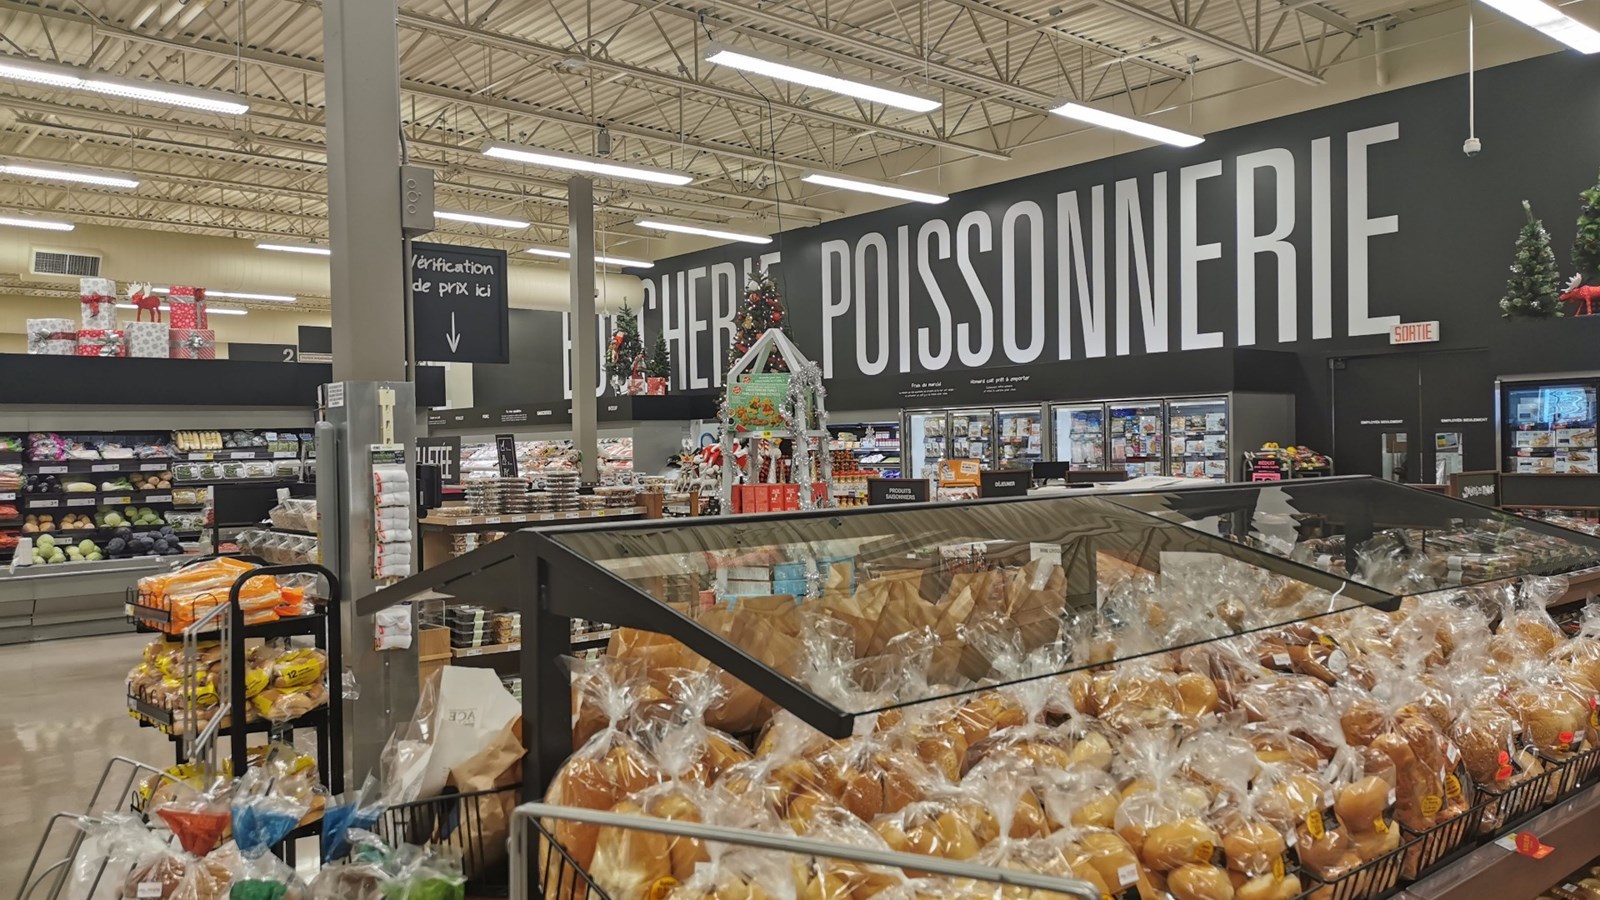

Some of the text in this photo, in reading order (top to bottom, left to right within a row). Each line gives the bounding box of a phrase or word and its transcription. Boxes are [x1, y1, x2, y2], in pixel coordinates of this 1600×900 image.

[820, 121, 1402, 381] POISSONNERIE
[412, 277, 491, 298] de prix ici
[1394, 323, 1432, 342] SORTIE
[282, 348, 295, 363] 2
[287, 669, 298, 680] 12
